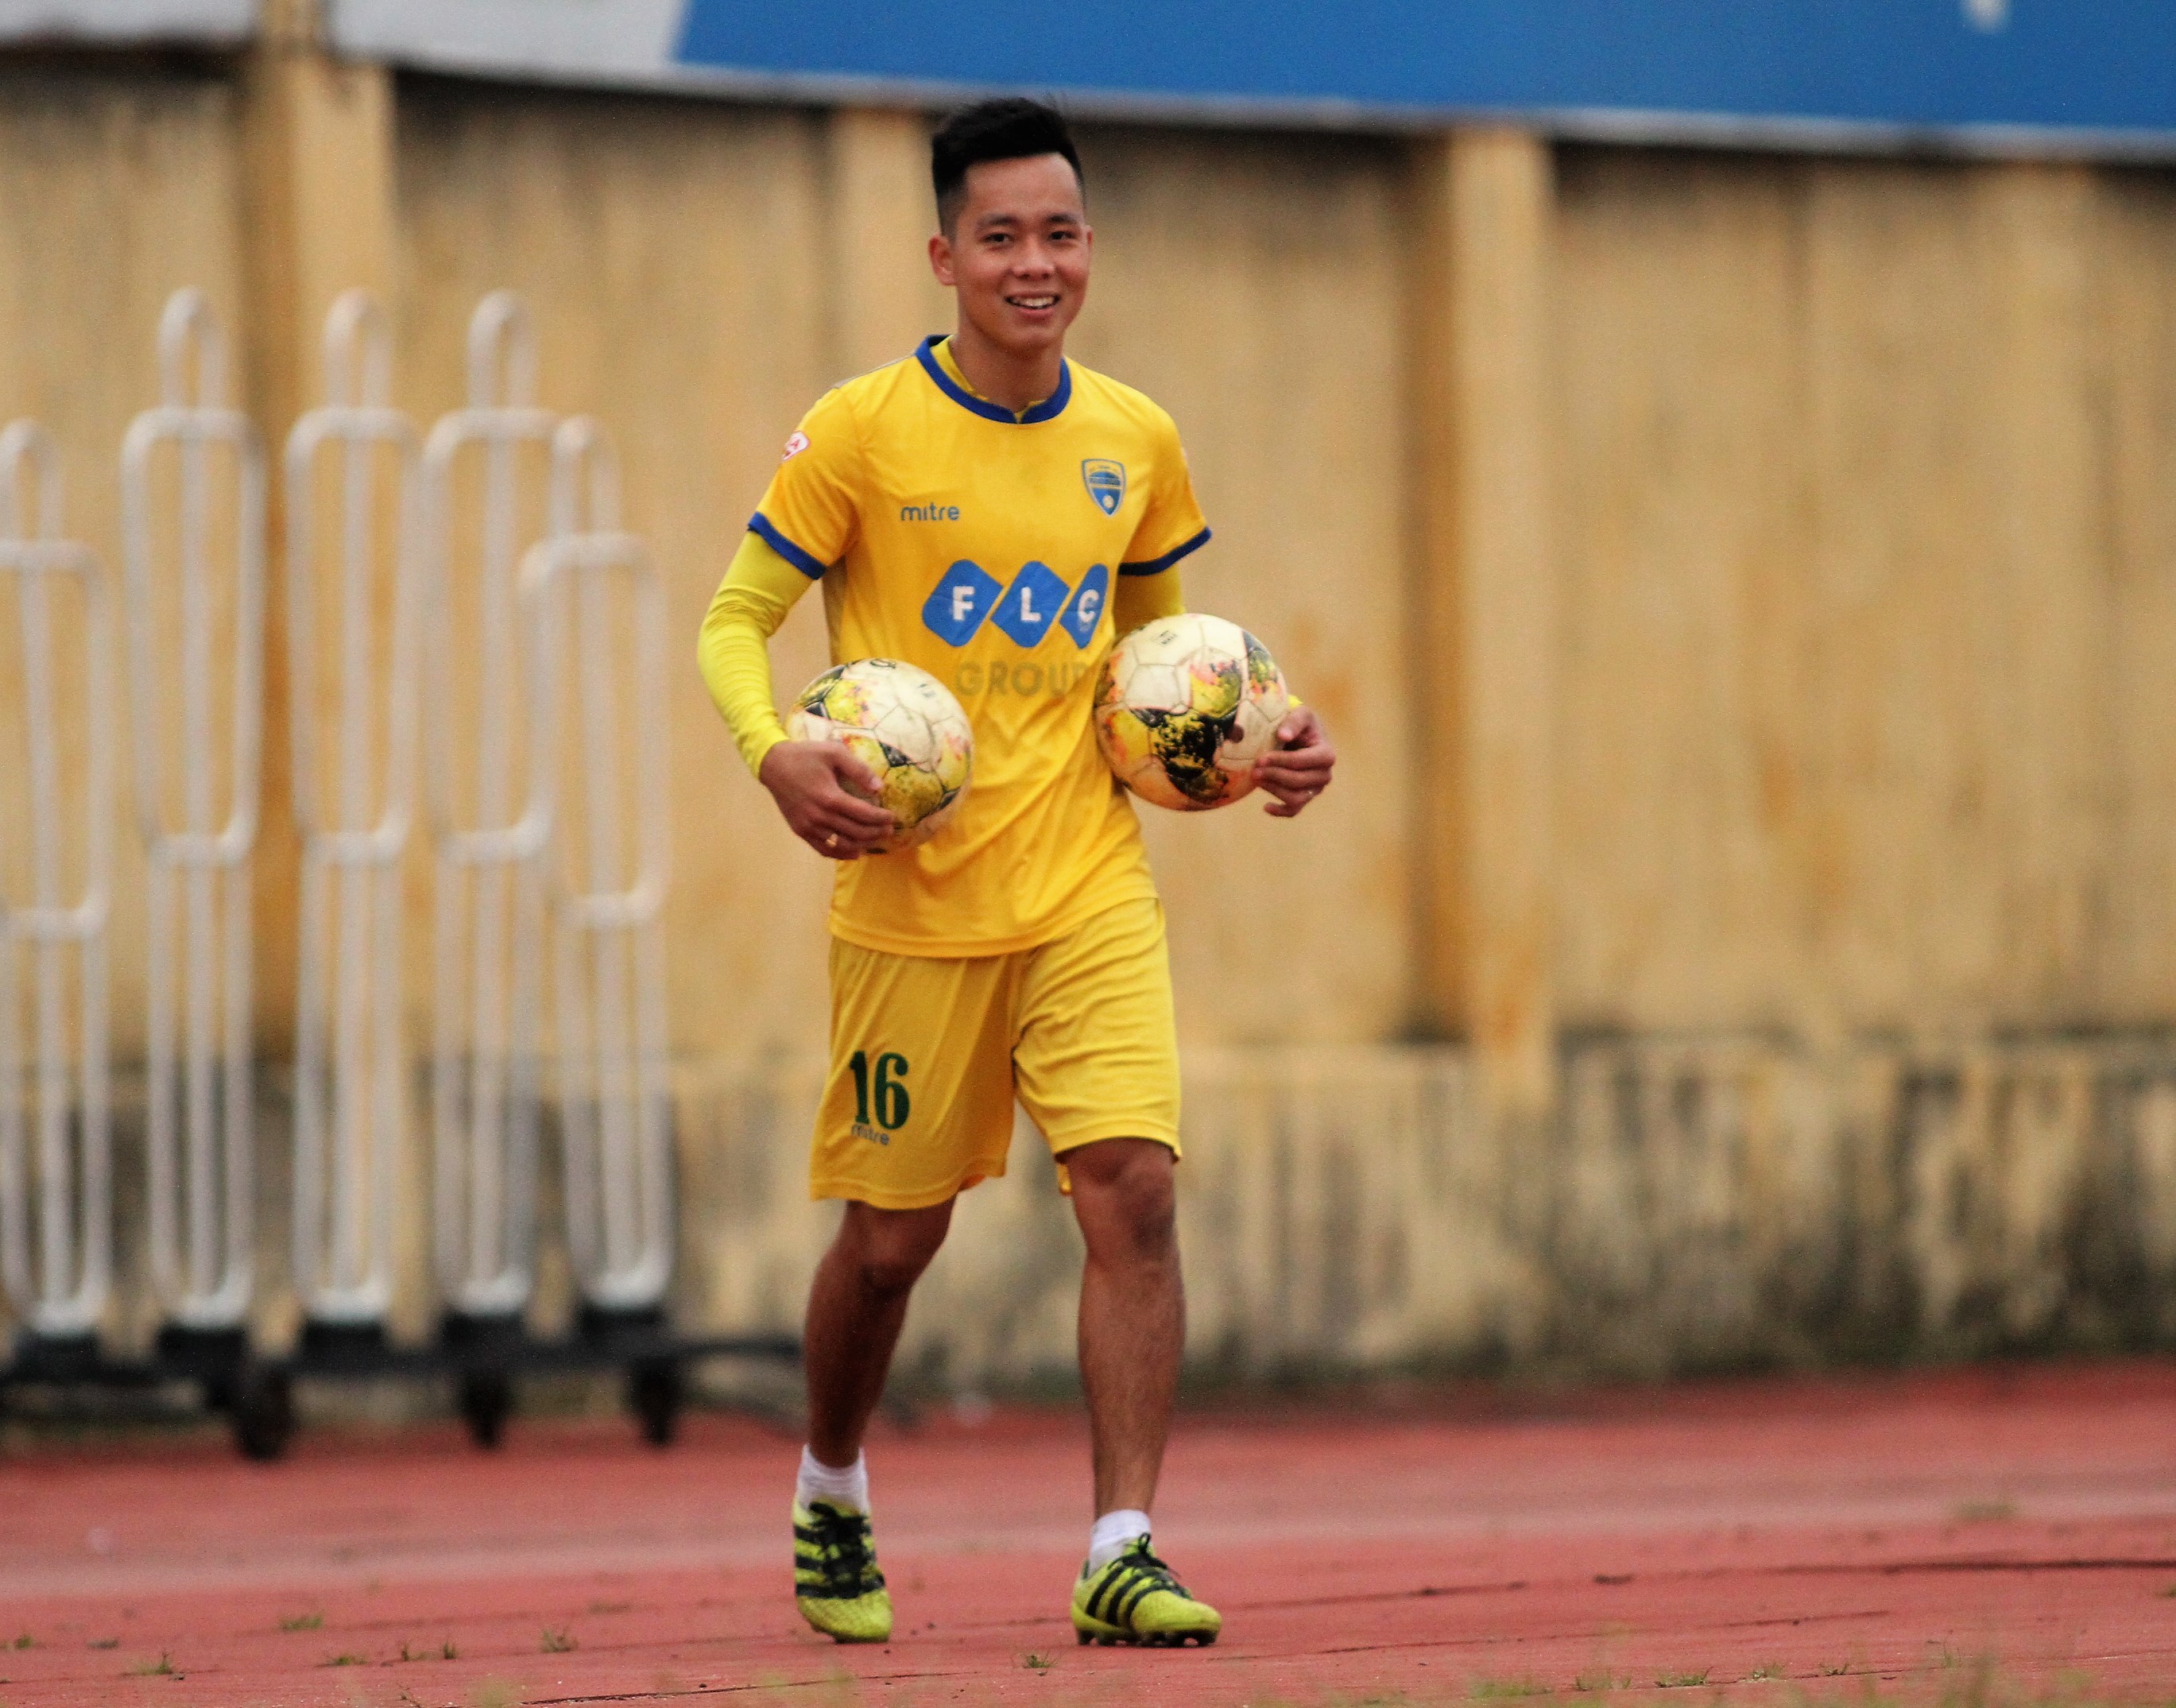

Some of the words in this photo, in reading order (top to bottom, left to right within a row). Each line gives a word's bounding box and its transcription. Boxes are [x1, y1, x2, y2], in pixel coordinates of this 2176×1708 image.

[901, 502, 959, 521] mitre
[953, 586, 1099, 622] FLC
[849, 1051, 910, 1129] 16
